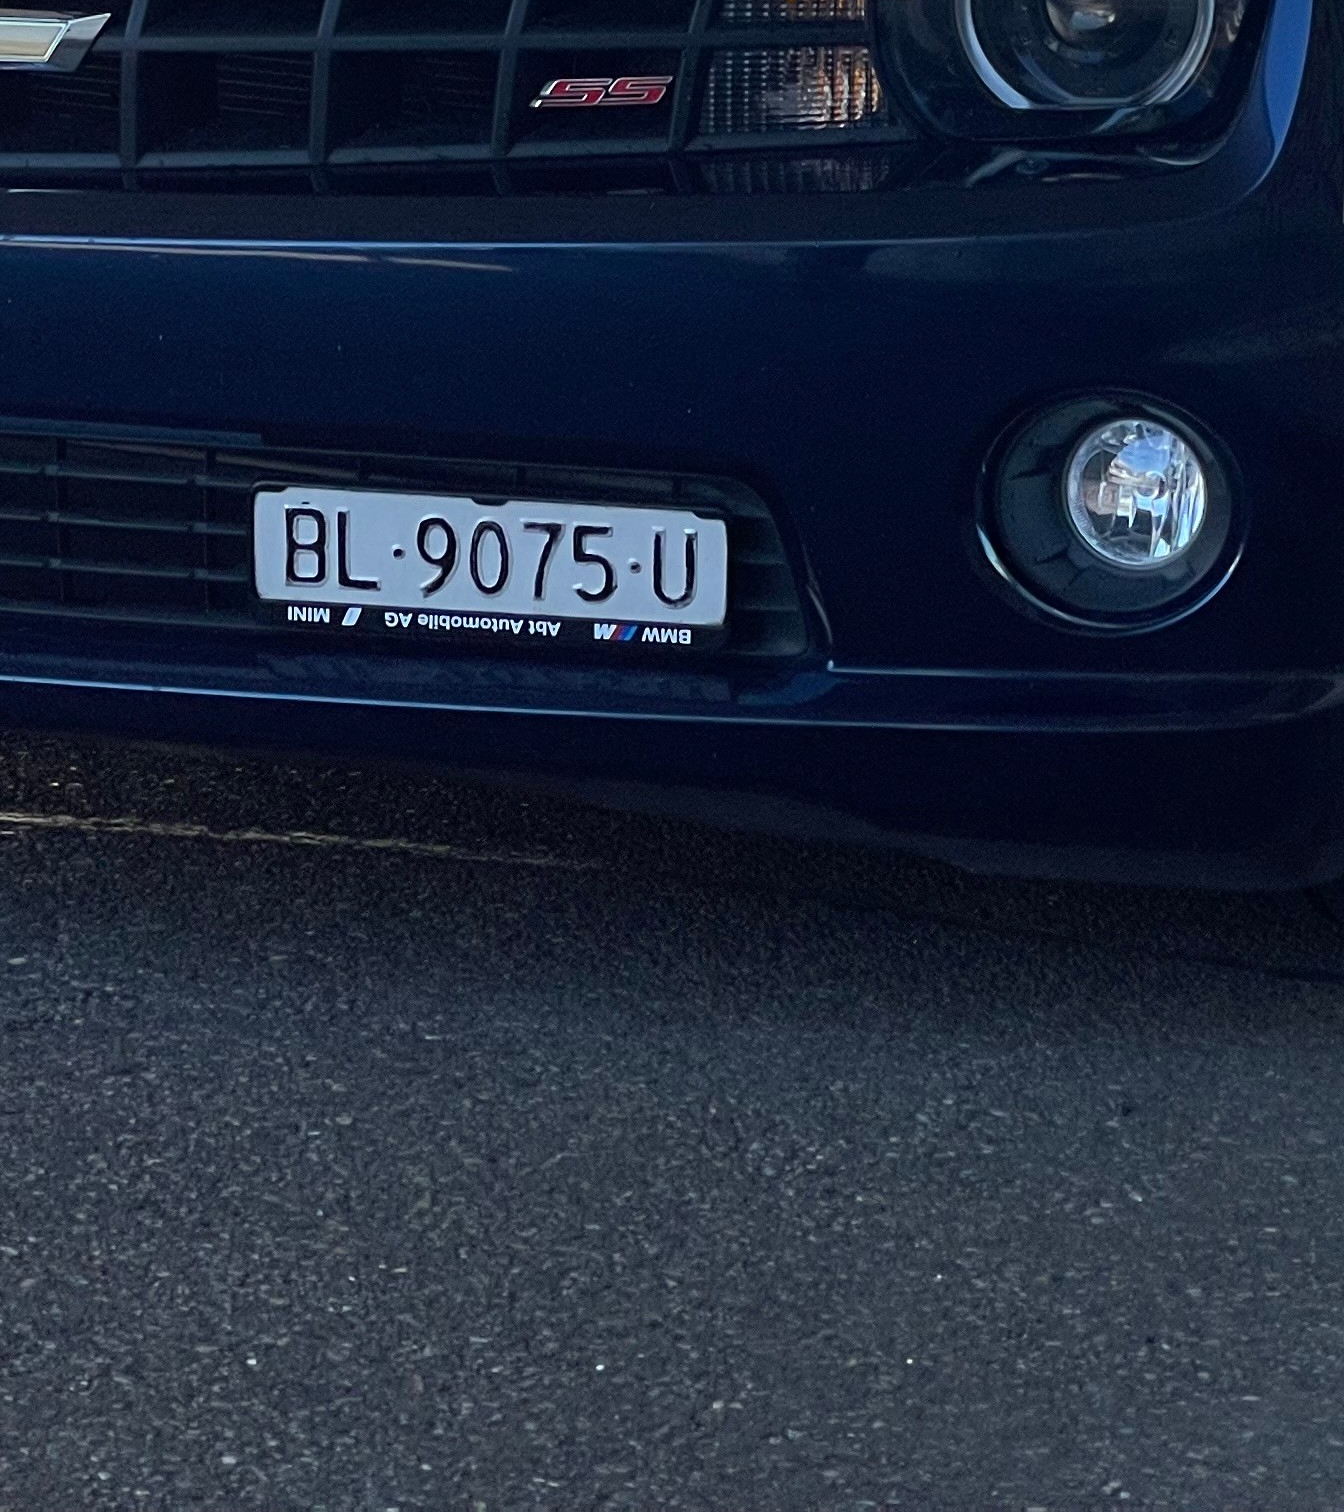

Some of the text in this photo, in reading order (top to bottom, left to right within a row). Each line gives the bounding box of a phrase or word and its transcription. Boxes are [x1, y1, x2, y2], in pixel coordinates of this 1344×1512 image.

[529, 75, 674, 107] SS
[287, 606, 330, 623] MINI
[384, 612, 413, 627] AG
[417, 613, 524, 634] Automobile
[528, 620, 561, 637] Abt
[641, 627, 692, 644] BMW
